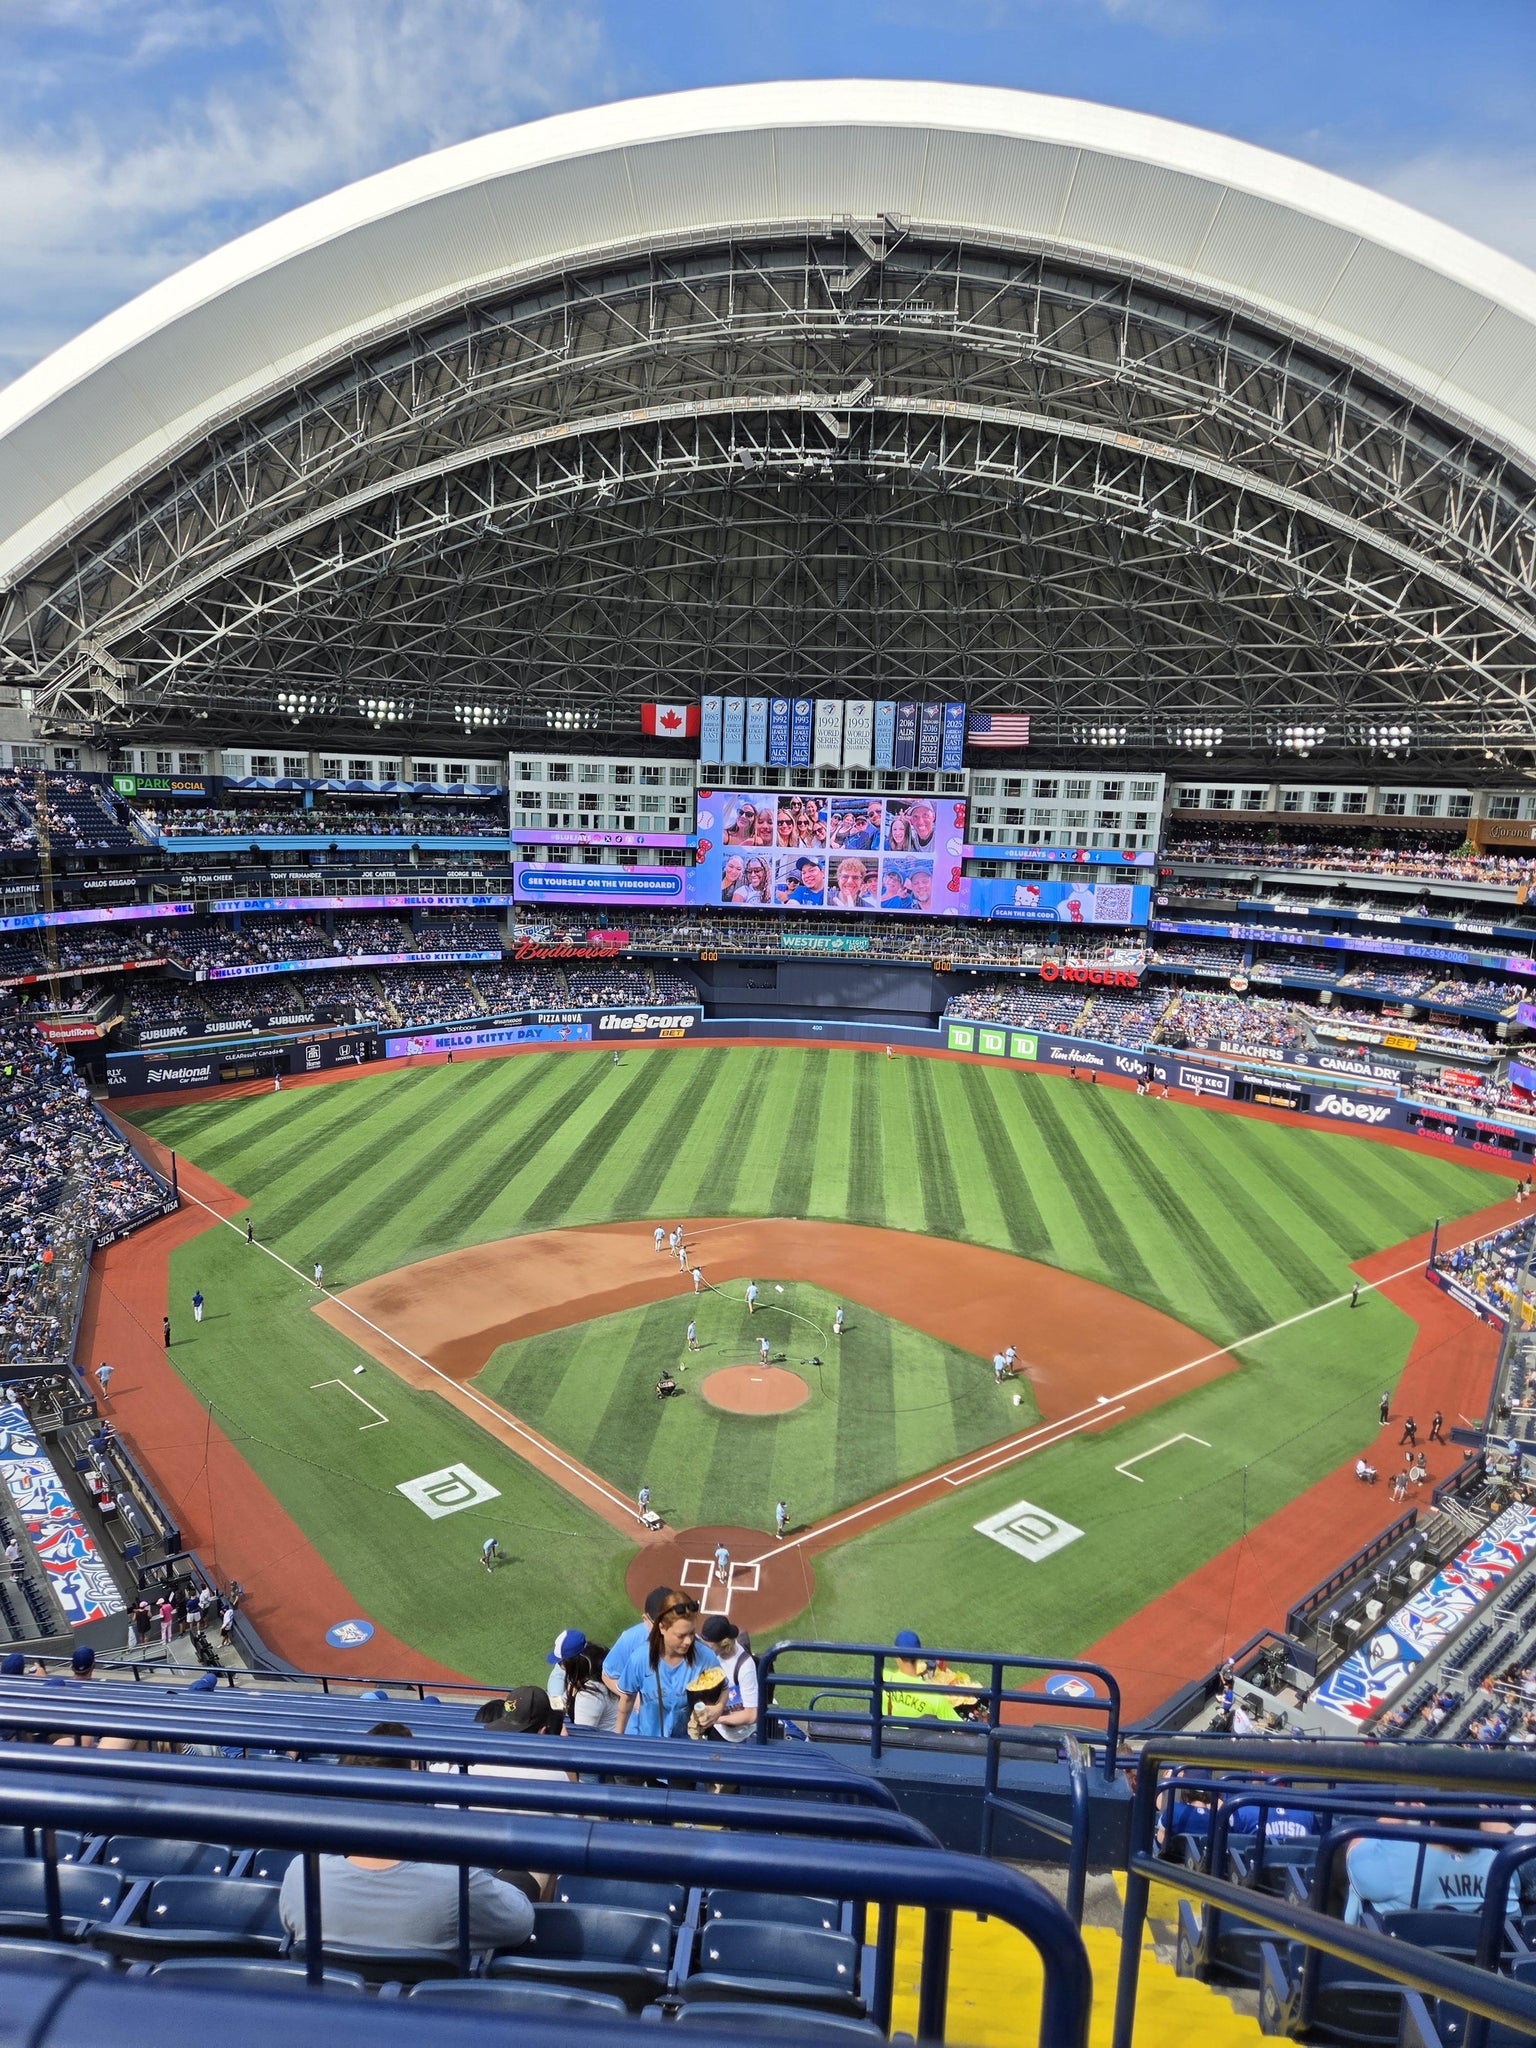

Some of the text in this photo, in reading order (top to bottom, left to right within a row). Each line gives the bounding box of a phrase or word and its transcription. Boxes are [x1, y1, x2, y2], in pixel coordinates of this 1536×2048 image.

[772, 715, 787, 723] 1992
[795, 716, 809, 724] 1993
[819, 717, 839, 727] 1992
[900, 719, 914, 727] 2016
[946, 720, 962, 728] 2025
[923, 724, 938, 732] 2016
[922, 735, 938, 743] 2020
[921, 746, 937, 754] 2022
[945, 753, 961, 761] ALCS
[920, 756, 937, 764] 2023
[115, 778, 205, 792] TD PARK SOCIAL
[1490, 825, 1529, 839] Corona
[5, 884, 41, 893] MARTINEZ
[84, 879, 136, 888] CARLOS DELGADO
[528, 877, 543, 885] SEE
[544, 878, 586, 887] YOURSELF
[601, 880, 617, 888] THE
[617, 881, 676, 889] VIDEOBOARD!
[244, 900, 266, 909] DAY
[437, 896, 468, 904] KITTY
[472, 896, 493, 904] DAY
[996, 909, 1012, 917] SCAN
[1037, 911, 1055, 919] CODE
[782, 937, 831, 948] WESTJET
[514, 942, 620, 960] Budweiser
[1409, 946, 1468, 962] 647-559-0060
[216, 963, 291, 978] HELLO KITTY DAY
[1062, 966, 1138, 988] ROGERS
[1194, 968, 1219, 977] CANADA
[268, 1014, 315, 1026] SUBWAY
[538, 1013, 582, 1024] PIZZA NOVA
[599, 1013, 695, 1030] theScore
[140, 1026, 188, 1041] SUBWAY
[205, 1020, 253, 1034] SUBWAY
[436, 1029, 543, 1048] HELLO KITTY DAY
[953, 1032, 971, 1047] TD
[982, 1034, 1003, 1050] TD
[1316, 1026, 1416, 1049] theScore BET
[1014, 1038, 1035, 1054] TD
[1220, 1042, 1284, 1061] BLEACHERS
[1050, 1047, 1104, 1066] Tim Hortons
[162, 1065, 211, 1080] National
[1319, 1057, 1372, 1076] CANADA
[1185, 1074, 1223, 1088] THE KEG
[1315, 1094, 1391, 1123] Sobeys
[1428, 1110, 1457, 1123] ROGERS
[1425, 1130, 1454, 1144] ROGERS
[1485, 1123, 1515, 1137] ROGERS
[1481, 1144, 1512, 1159] ROGERS
[162, 1199, 179, 1214] VISA
[422, 1471, 477, 1506] TD
[993, 1513, 1059, 1545] TD
[885, 1689, 927, 1714] SNACKS
[1256, 1821, 1307, 1838] AUTISTA
[1438, 1873, 1486, 1899] KIRK
